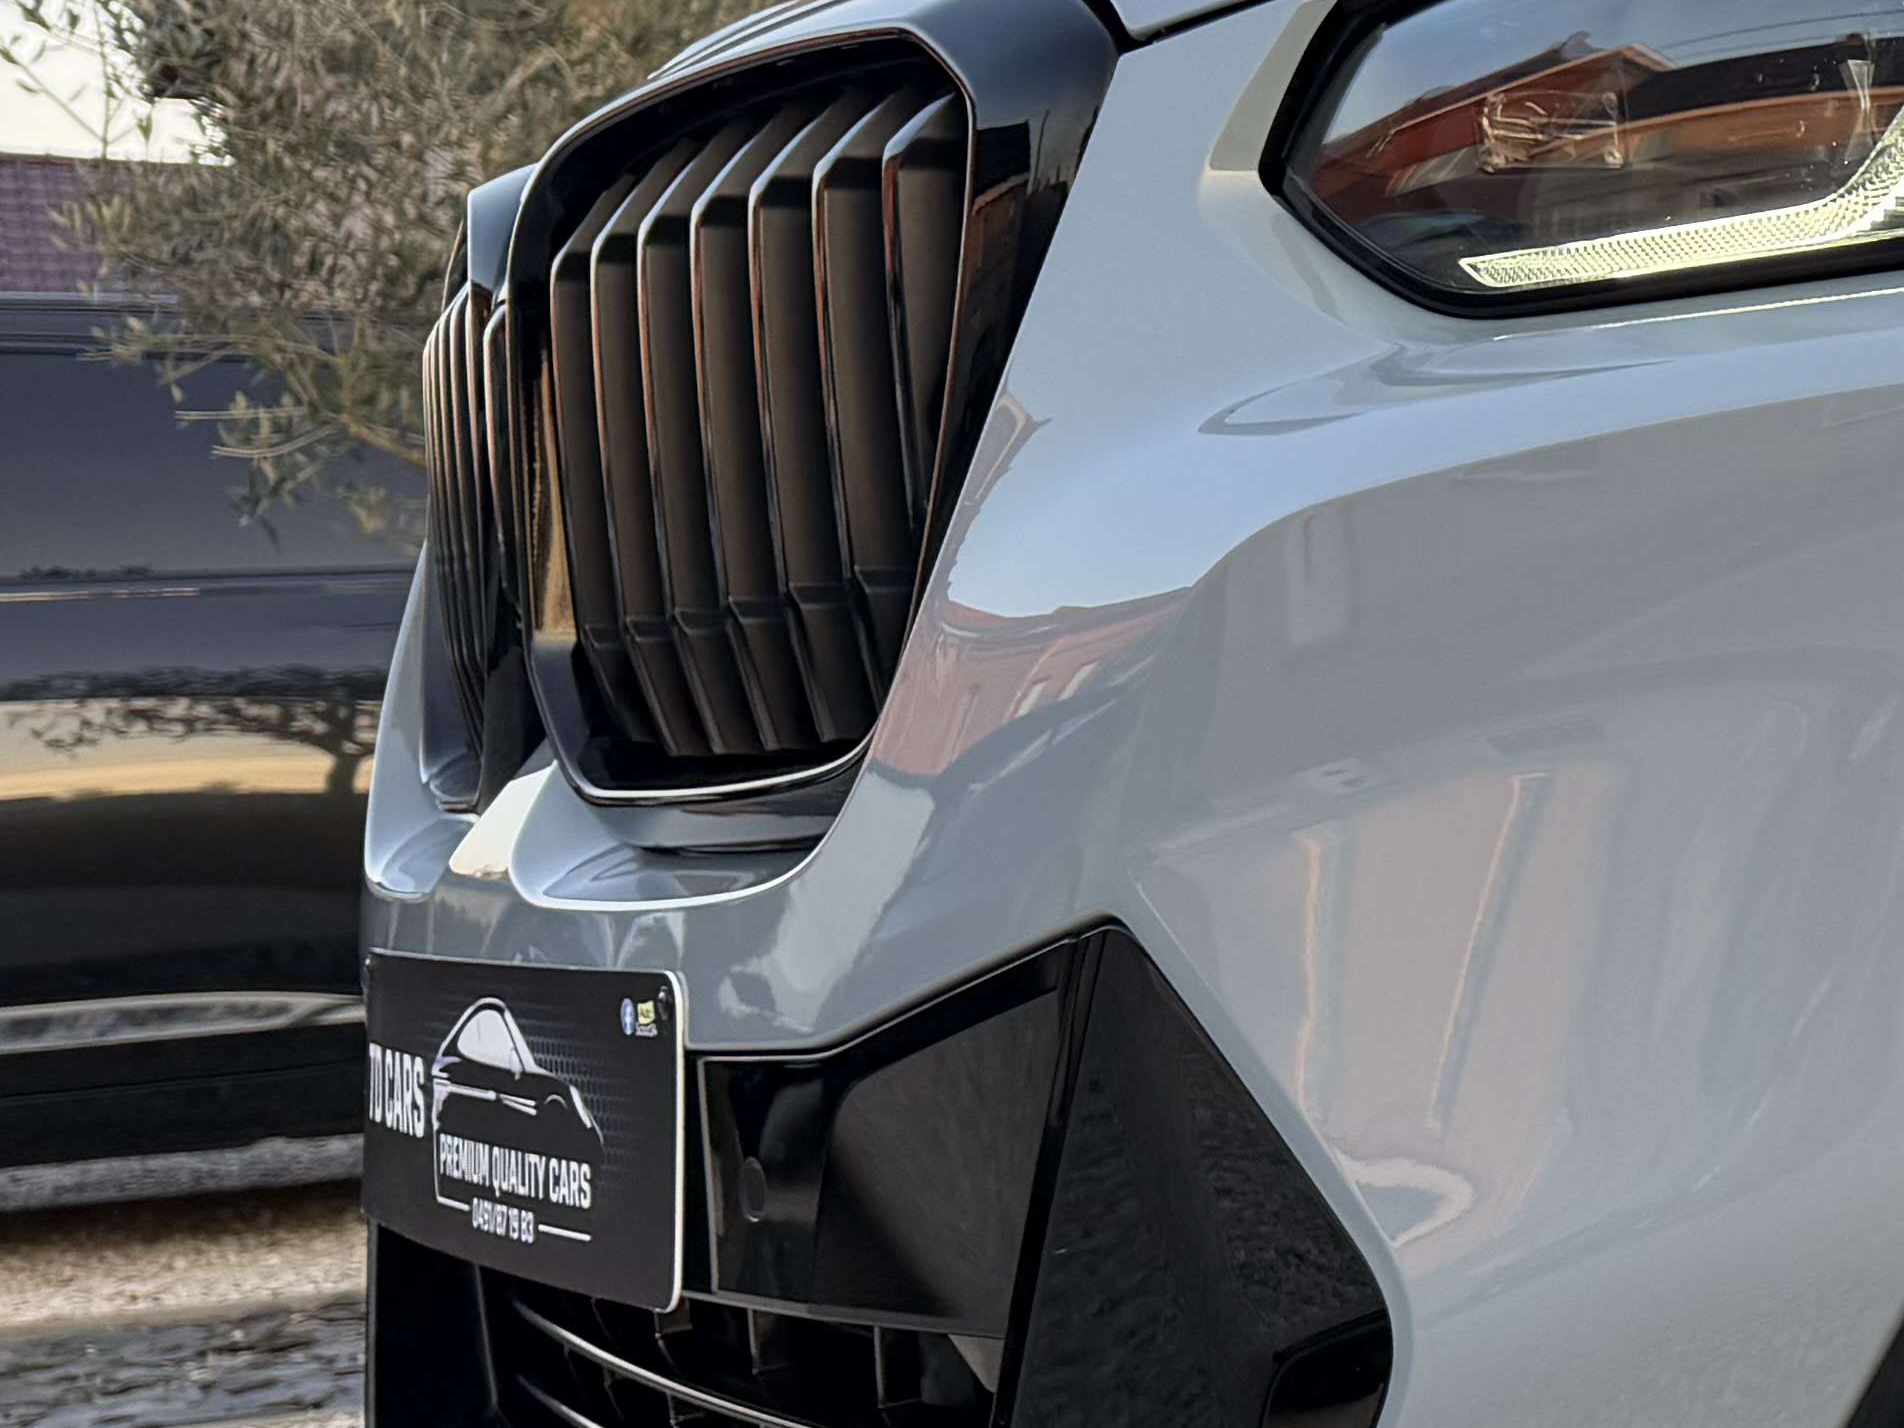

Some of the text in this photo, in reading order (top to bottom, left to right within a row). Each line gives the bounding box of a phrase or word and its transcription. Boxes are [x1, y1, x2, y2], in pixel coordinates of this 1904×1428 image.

[385, 1048, 425, 1138] CARS
[439, 1132, 592, 1209] PREMIUM QUALITY CARS
